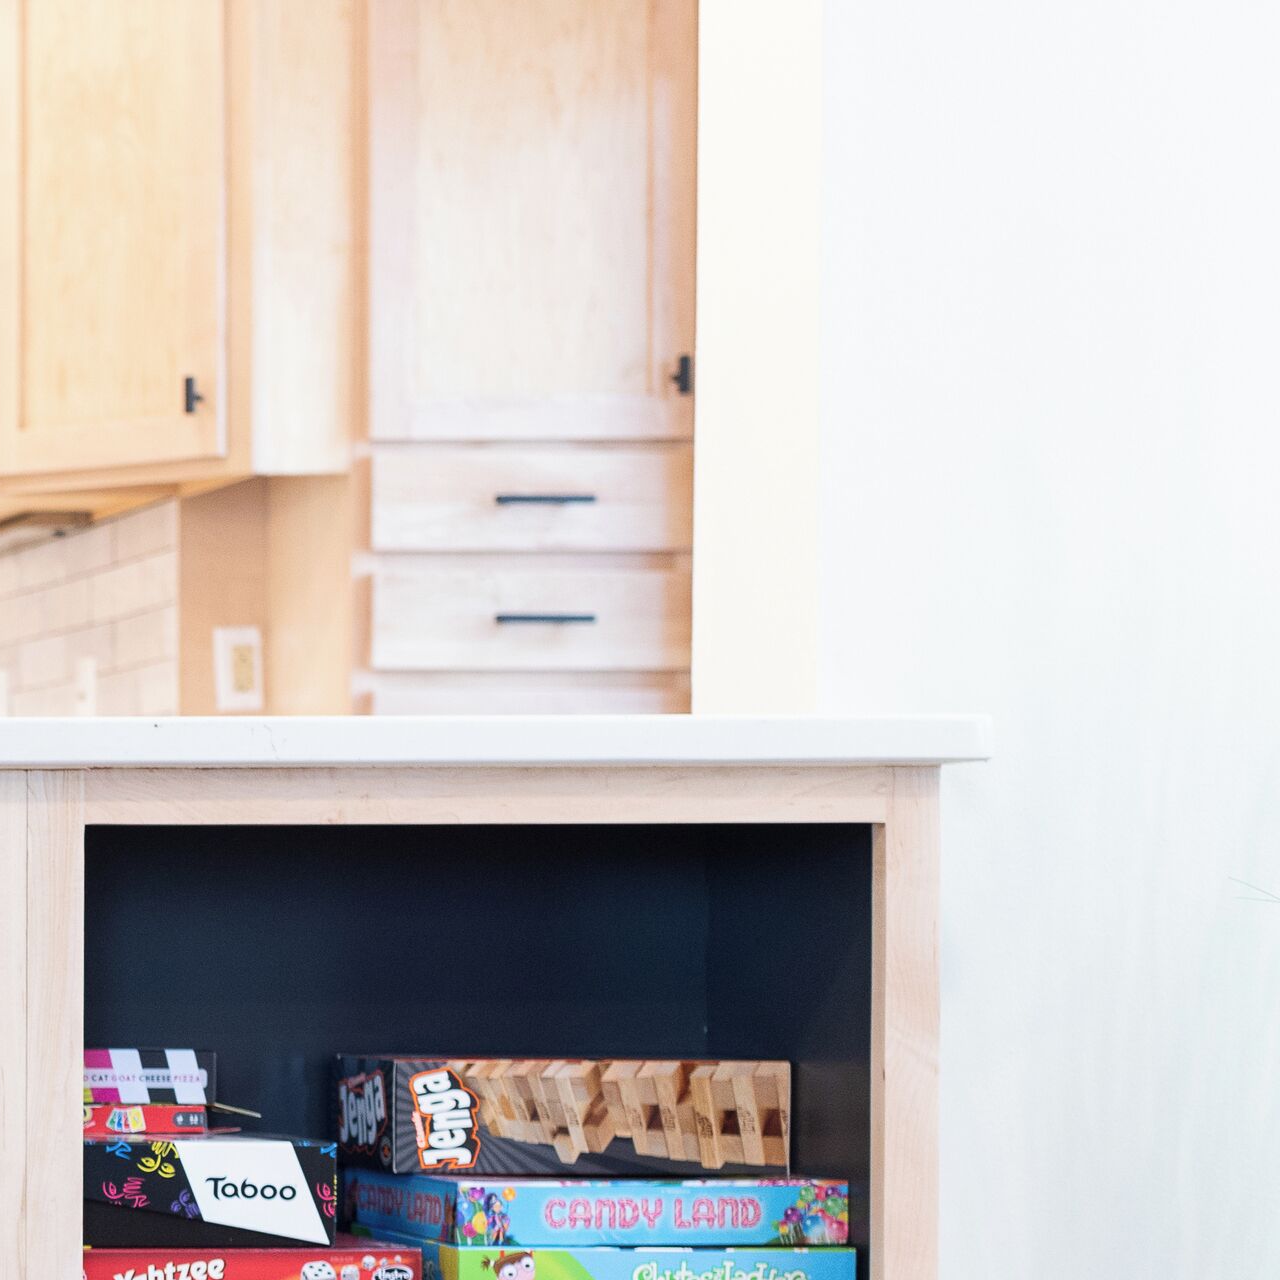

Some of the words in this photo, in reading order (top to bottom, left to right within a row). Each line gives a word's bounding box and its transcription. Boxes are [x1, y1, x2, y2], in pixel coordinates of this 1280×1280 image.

[340, 1074, 385, 1146] Jenga
[413, 1071, 473, 1166] Jenga
[205, 1176, 297, 1201] Taboo
[358, 1183, 403, 1218] CANDY
[407, 1192, 441, 1225] LAND
[544, 1198, 663, 1230] CANDY
[674, 1197, 762, 1230] LAND
